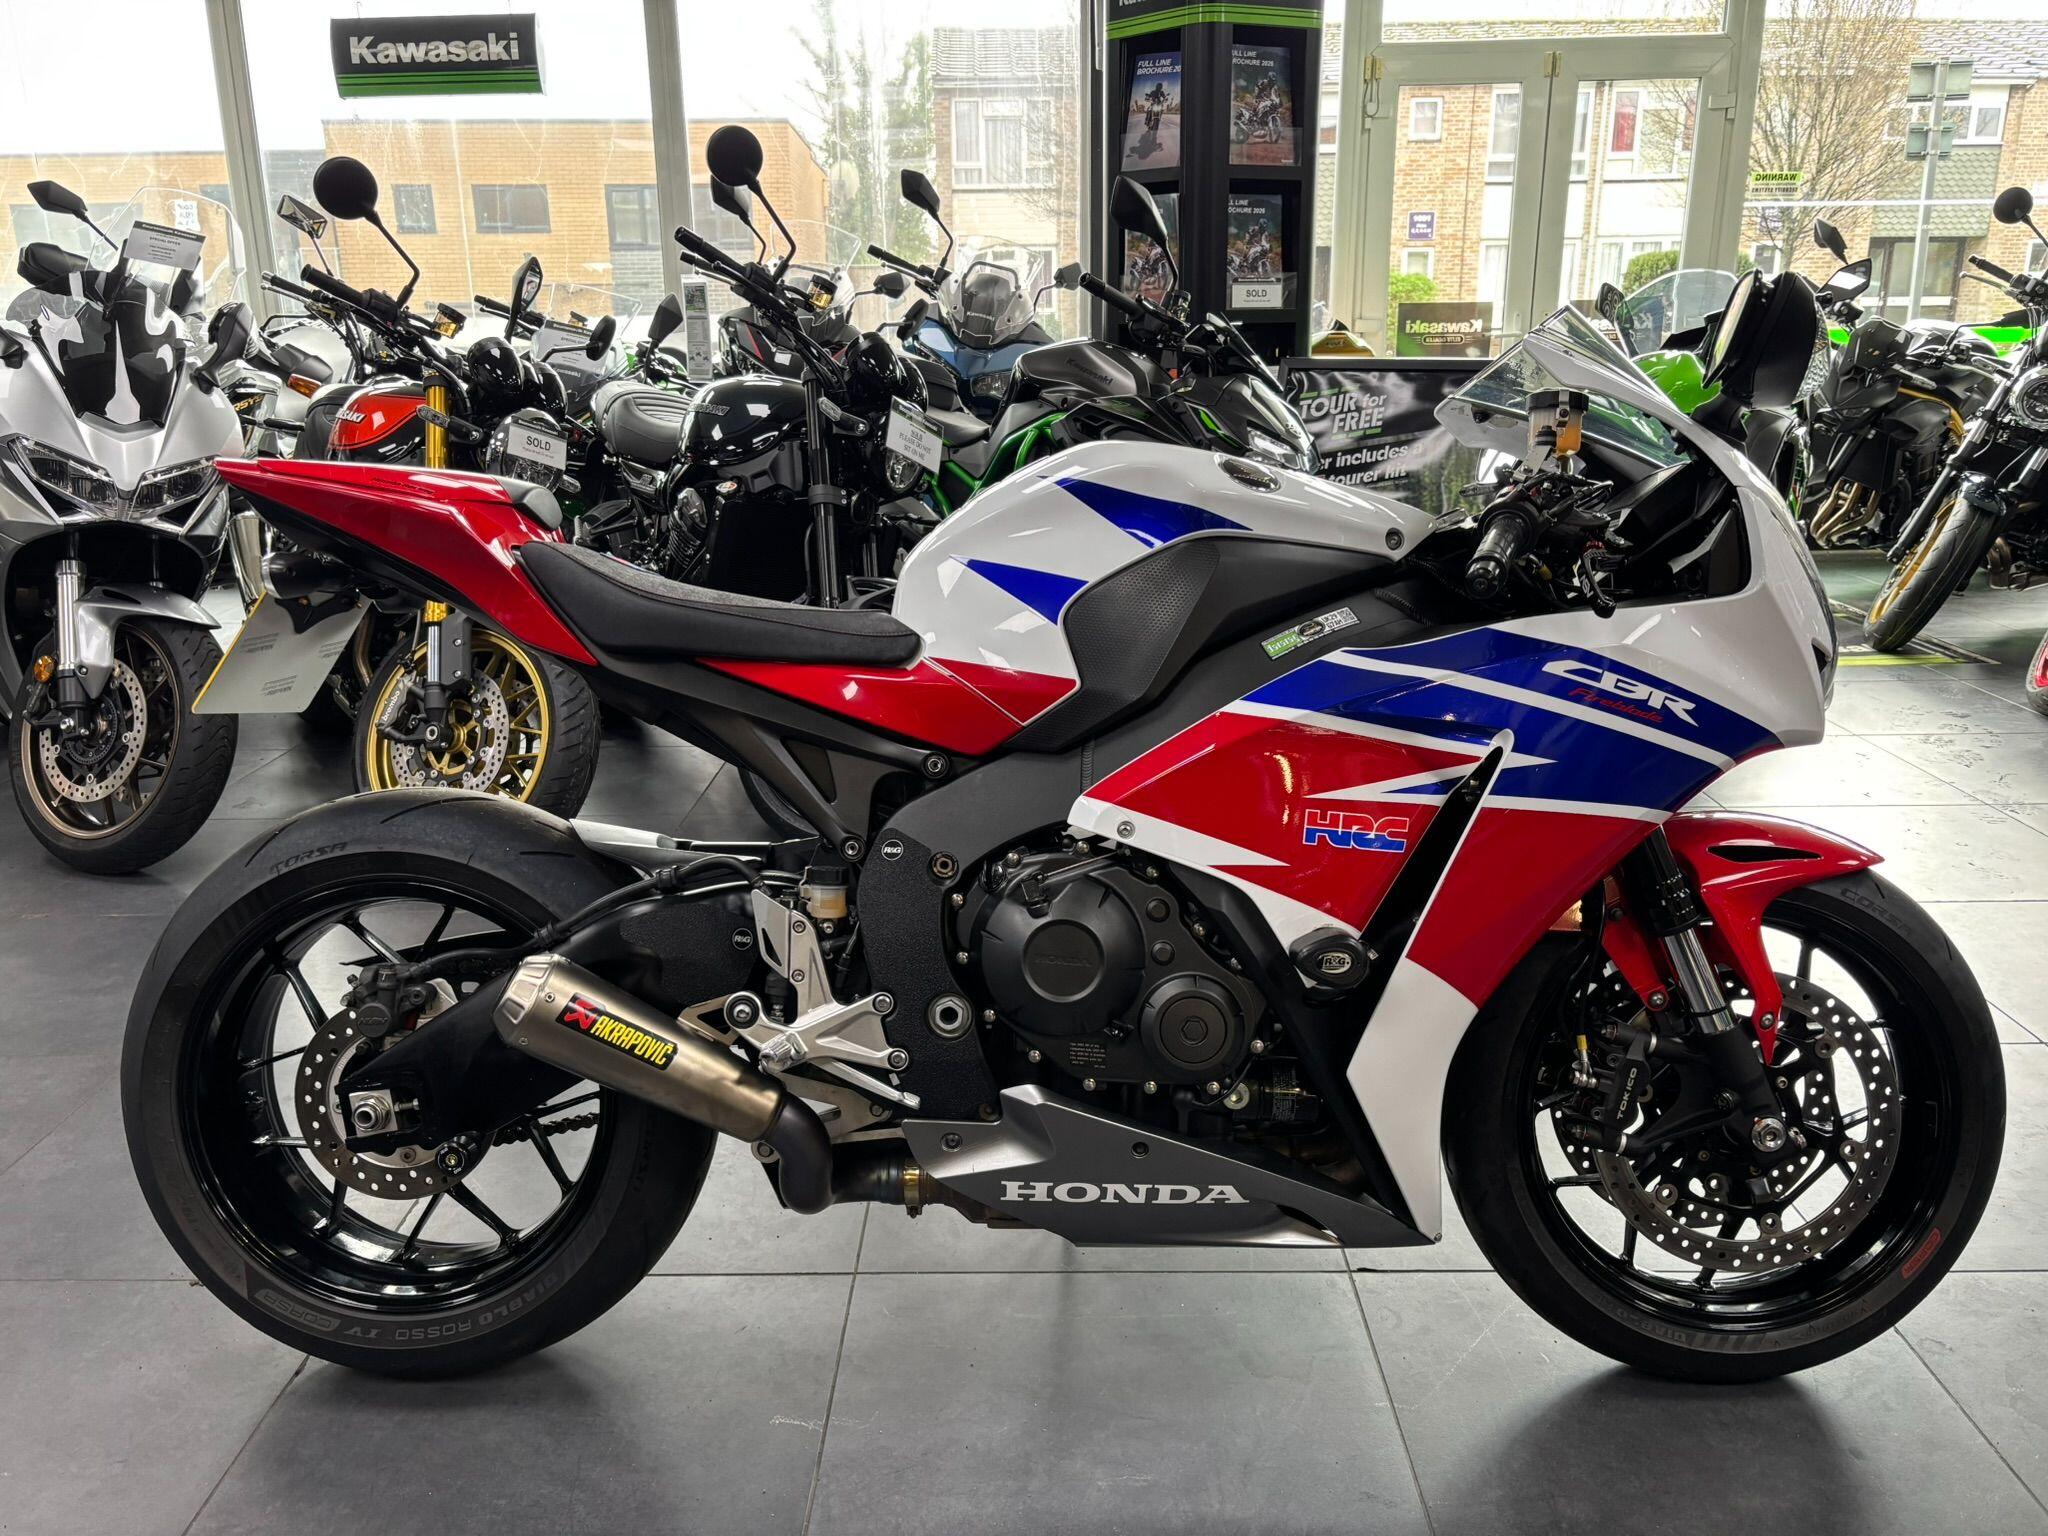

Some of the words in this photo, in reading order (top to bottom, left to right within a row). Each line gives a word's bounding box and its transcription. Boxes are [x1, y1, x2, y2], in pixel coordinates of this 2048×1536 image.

[350, 33, 519, 64] Kawasaki
[1137, 67, 1174, 75] BROCHURE
[1246, 289, 1267, 297] SOLD
[1066, 357, 1113, 386] Kawasaki
[1300, 392, 1359, 419] TOUR
[1362, 393, 1387, 407] for
[1332, 407, 1385, 433] FREE
[526, 435, 551, 451] SOLD
[1335, 444, 1409, 469] includes
[1328, 470, 1383, 486] tourer
[381, 690, 400, 721] brembo
[1542, 659, 1699, 727] CBR
[1568, 688, 1664, 724] Fireblade
[1303, 809, 1409, 853] HRC
[1616, 1067, 1637, 1120] TOKICO
[1000, 1180, 1250, 1204] HONDA
[263, 1291, 333, 1329] CORSA
[394, 1319, 471, 1340] ROSSO
